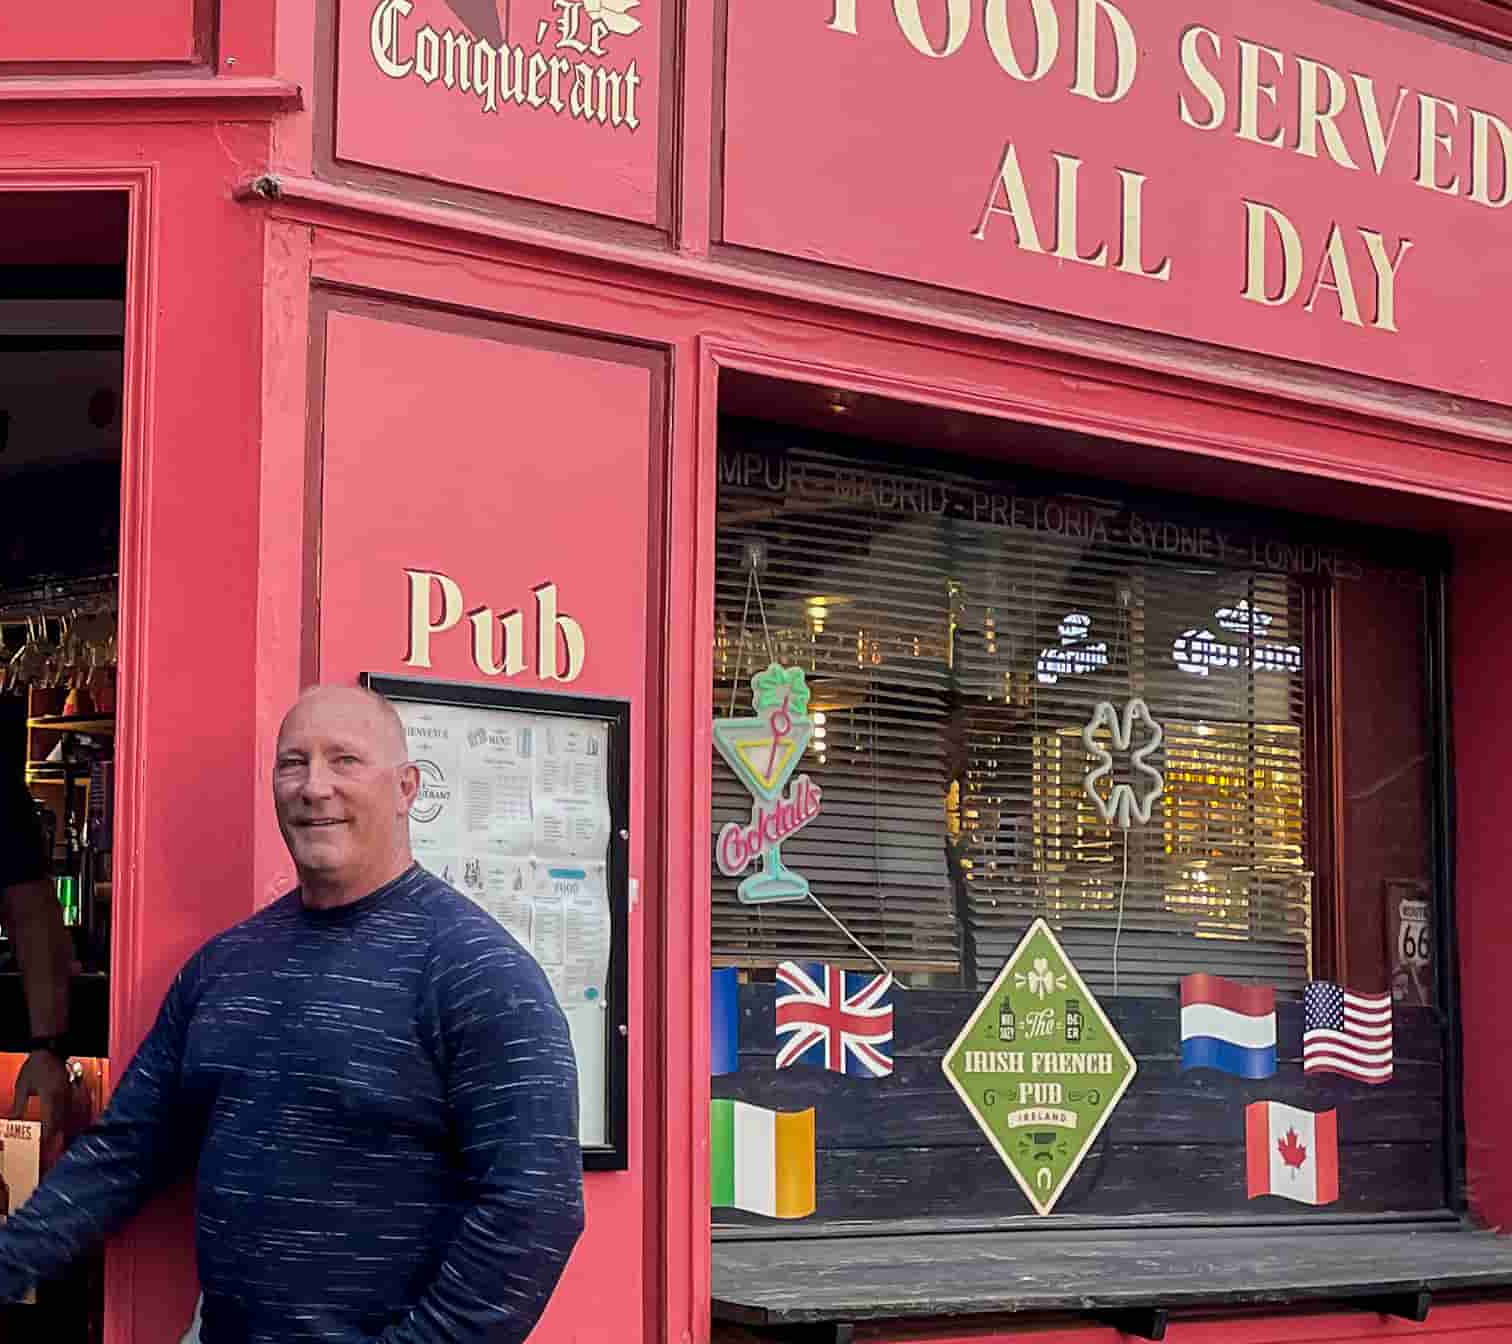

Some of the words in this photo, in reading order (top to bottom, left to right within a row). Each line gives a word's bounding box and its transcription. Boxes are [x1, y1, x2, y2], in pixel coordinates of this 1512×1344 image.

[1177, 23, 1512, 209] SERVED
[969, 141, 1172, 282] ALL
[1238, 197, 1415, 334] DAY
[401, 567, 586, 684] Pub
[1403, 922, 1431, 959] 66
[1024, 1008, 1056, 1040] The
[965, 1051, 1025, 1073] IRISH
[1031, 1052, 1113, 1075] FRENCH
[1018, 1082, 1064, 1104] PUB
